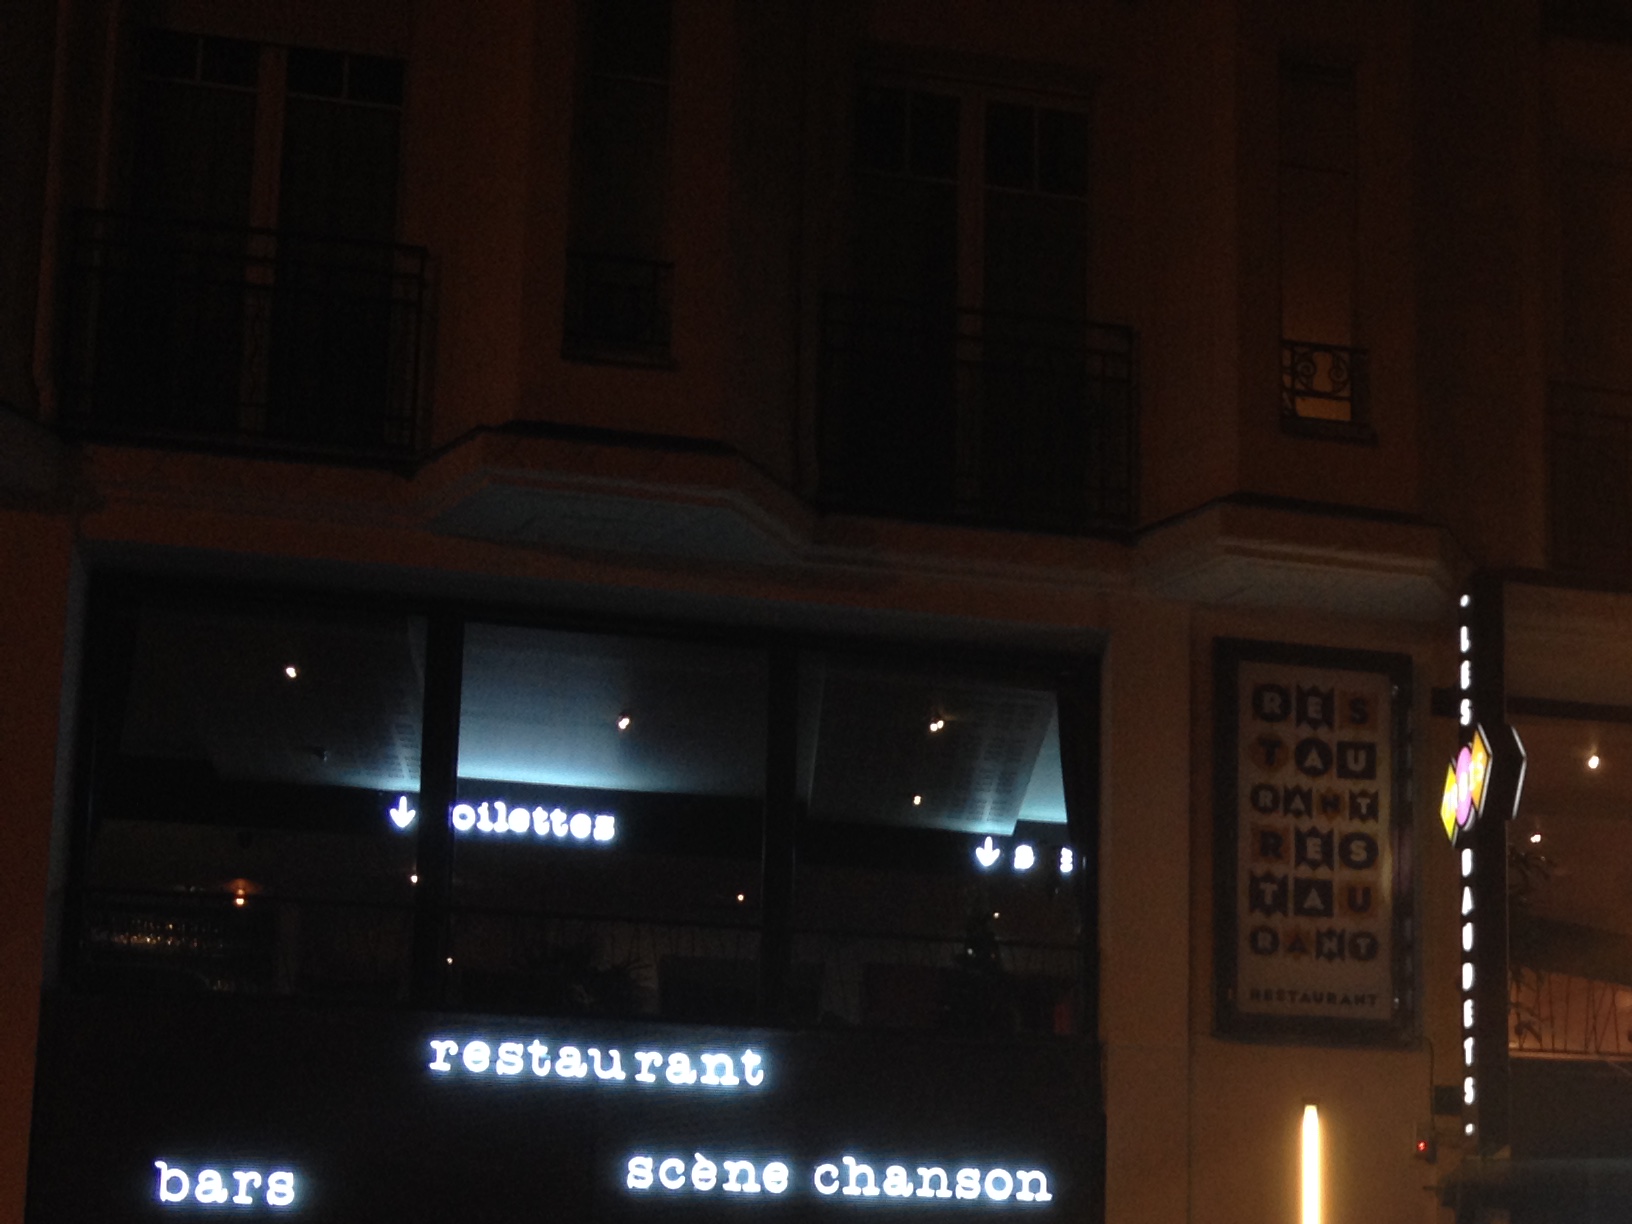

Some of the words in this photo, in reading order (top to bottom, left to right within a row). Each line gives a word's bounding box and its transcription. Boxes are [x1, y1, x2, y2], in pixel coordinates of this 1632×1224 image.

[450, 800, 616, 842] oilettes
[428, 1036, 766, 1088] restaurant
[154, 1159, 296, 1207] bars
[626, 1151, 790, 1195] scène
[813, 1154, 1053, 1203] chanson
